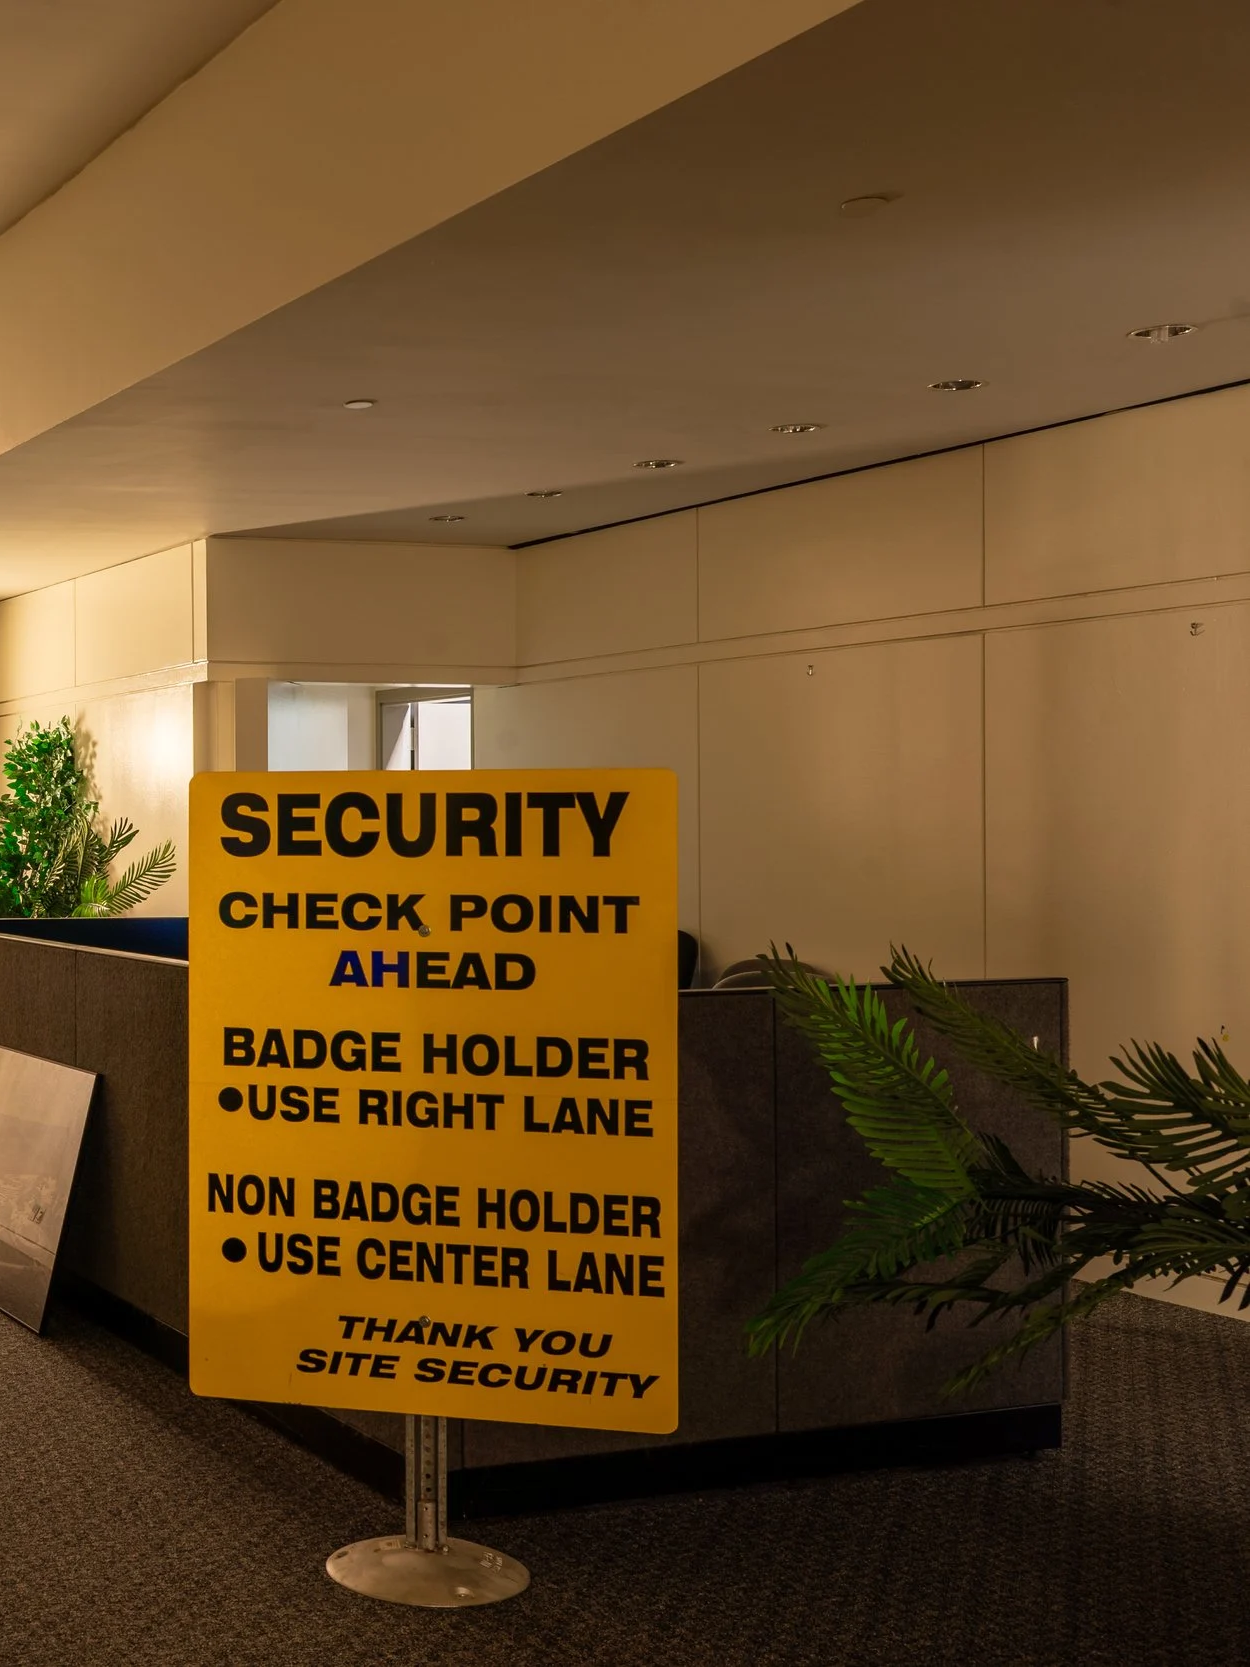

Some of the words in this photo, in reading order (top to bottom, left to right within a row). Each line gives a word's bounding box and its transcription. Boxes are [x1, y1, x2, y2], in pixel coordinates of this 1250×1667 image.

[219, 791, 630, 858] SECURITY
[218, 891, 429, 932] CHECK
[450, 894, 640, 934] POINT
[328, 950, 536, 991] AHEAD
[223, 1026, 402, 1073] BADGE
[422, 1033, 649, 1081] HOLDER
[248, 1084, 340, 1124] USE
[358, 1088, 505, 1131] RIGHT
[523, 1095, 654, 1138] LANE
[207, 1172, 295, 1218] NON
[313, 1178, 461, 1227] BADGE
[477, 1187, 662, 1239] HOLDER
[257, 1231, 342, 1277] USE
[356, 1237, 530, 1290] CENTER
[547, 1249, 665, 1298] LANE
[337, 1315, 499, 1351] THANK
[513, 1327, 613, 1359] YOU
[296, 1348, 401, 1380] SITE
[413, 1357, 660, 1399] SECURITY
